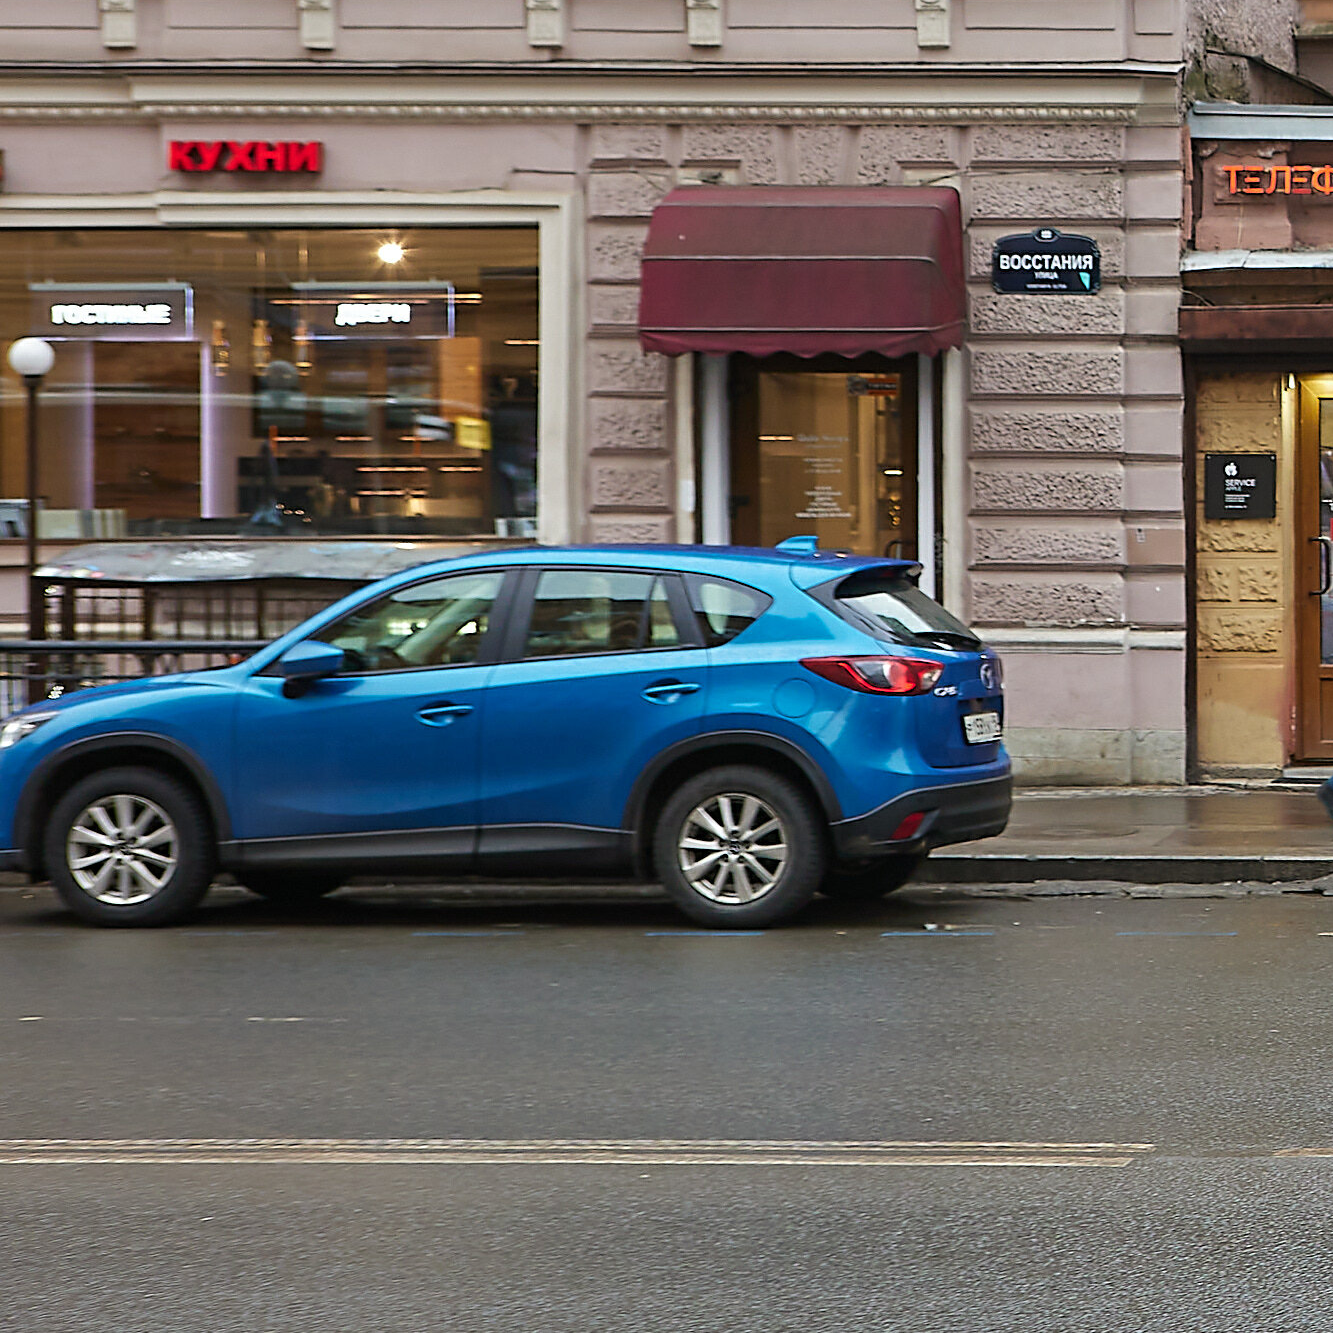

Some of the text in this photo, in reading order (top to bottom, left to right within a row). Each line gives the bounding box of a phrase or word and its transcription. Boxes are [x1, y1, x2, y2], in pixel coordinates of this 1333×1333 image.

[169, 141, 322, 172] КУХНИ
[999, 254, 1094, 270] ВОССТАНИЯ
[1225, 479, 1256, 487] SERVICE
